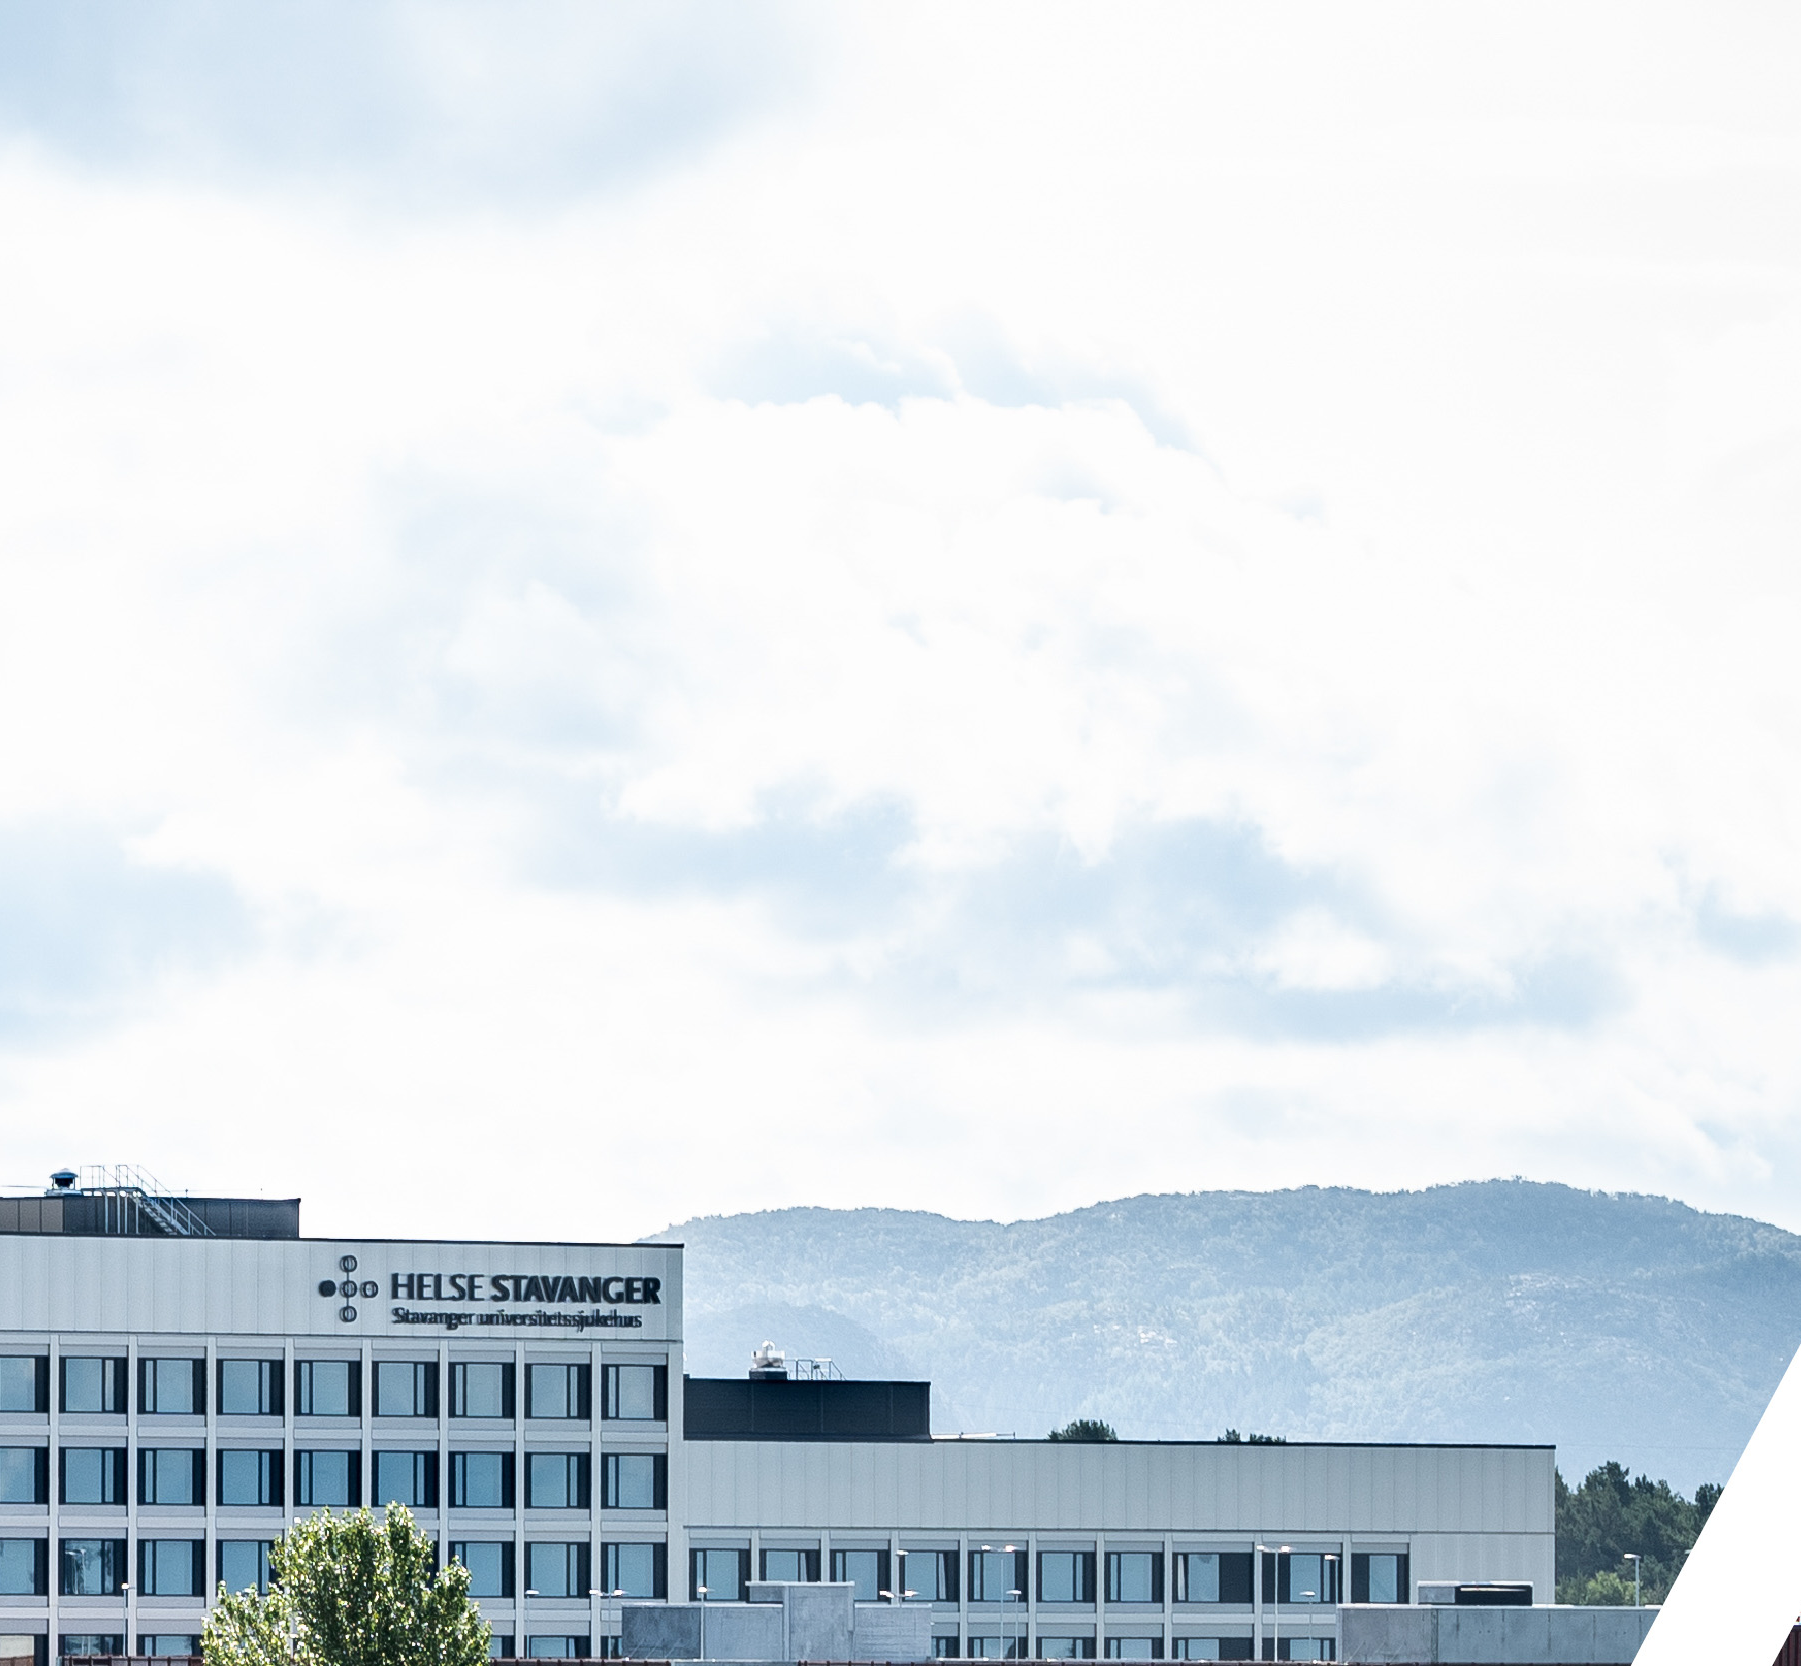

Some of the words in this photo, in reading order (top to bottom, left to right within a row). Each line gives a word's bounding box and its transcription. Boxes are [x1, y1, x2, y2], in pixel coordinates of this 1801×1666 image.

[391, 1273, 485, 1301] HELSE
[489, 1274, 661, 1305] STAVANGER
[392, 1307, 475, 1330] Stavanger
[478, 1308, 643, 1333] universitetssjukehus
